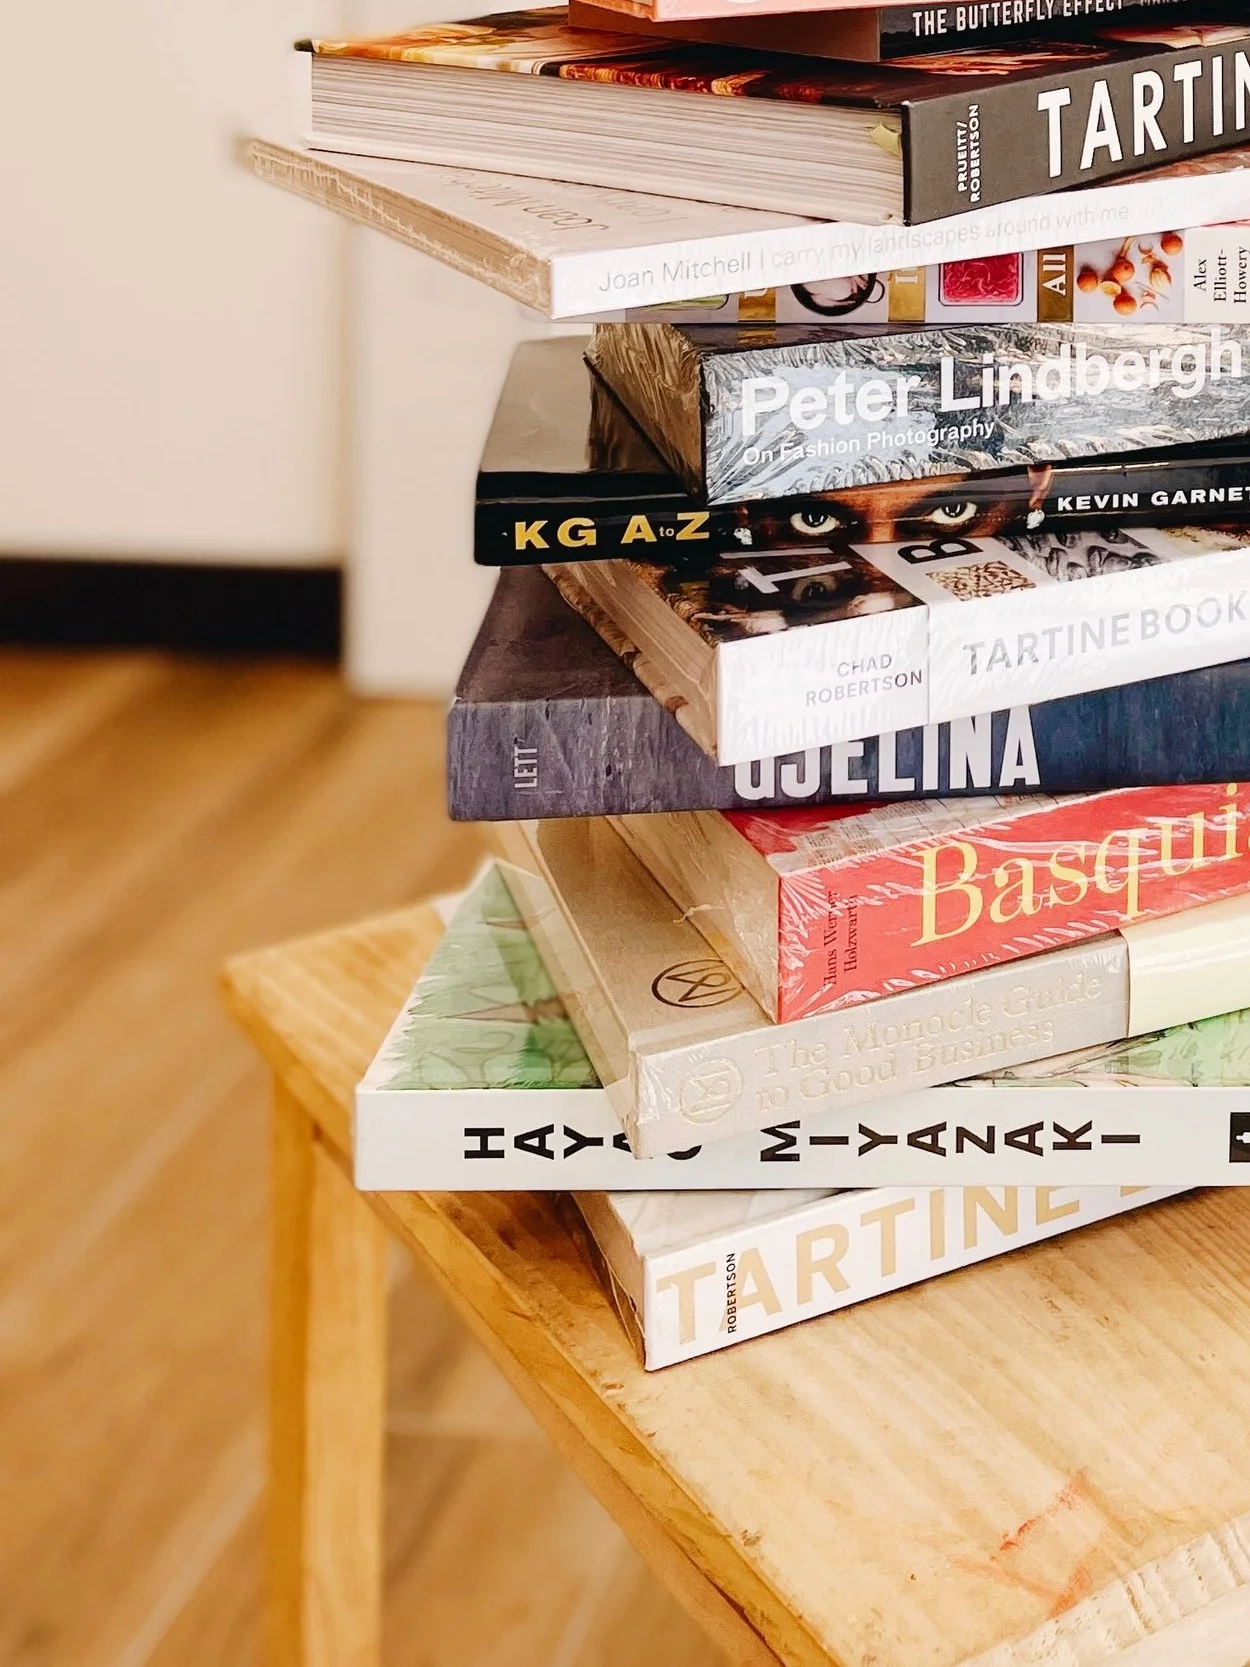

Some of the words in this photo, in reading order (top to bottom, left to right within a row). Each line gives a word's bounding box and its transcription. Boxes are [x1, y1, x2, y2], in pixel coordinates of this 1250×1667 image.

[912, 10, 948, 37] THE
[956, 121, 968, 192] PRUEITT/
[969, 104, 981, 203] ROBERTSON
[599, 269, 654, 292] Joan
[662, 251, 751, 283] Mitchell
[770, 244, 825, 271] carry
[831, 239, 861, 262] my
[868, 223, 981, 256] landscapes
[986, 215, 1050, 239] around
[1055, 206, 1095, 228] with
[1100, 205, 1129, 223] me
[1042, 253, 1067, 296] All
[1193, 258, 1207, 291] Alex
[1213, 247, 1227, 302] Elliott-
[1233, 246, 1250, 303] Howery
[740, 369, 921, 437] Peter
[940, 324, 1242, 413] Lindbergh
[741, 445, 774, 466] On
[780, 435, 860, 460] Fashion
[866, 419, 996, 451] Photography
[1057, 491, 1139, 512] KEVIN
[515, 517, 597, 550] KG
[620, 514, 658, 544] A
[659, 525, 675, 538] to
[675, 511, 710, 541] Z
[962, 612, 1131, 676] TARTINE
[1141, 591, 1248, 642] BOOK
[805, 669, 923, 707] ROBERTSON
[837, 654, 892, 677] CHAD
[514, 746, 538, 788] LETT
[823, 949, 837, 987] Hans
[754, 1038, 828, 1075] The
[842, 996, 993, 1060] Monocle
[1002, 972, 1103, 1018] Guide
[756, 1086, 790, 1114] to
[798, 1058, 898, 1100] Good
[912, 1016, 1056, 1073] Business
[760, 1120, 1141, 1162] MIYAZAKI
[656, 1186, 1081, 1346] TARTINE
[726, 1253, 737, 1334] ROBERTSON
